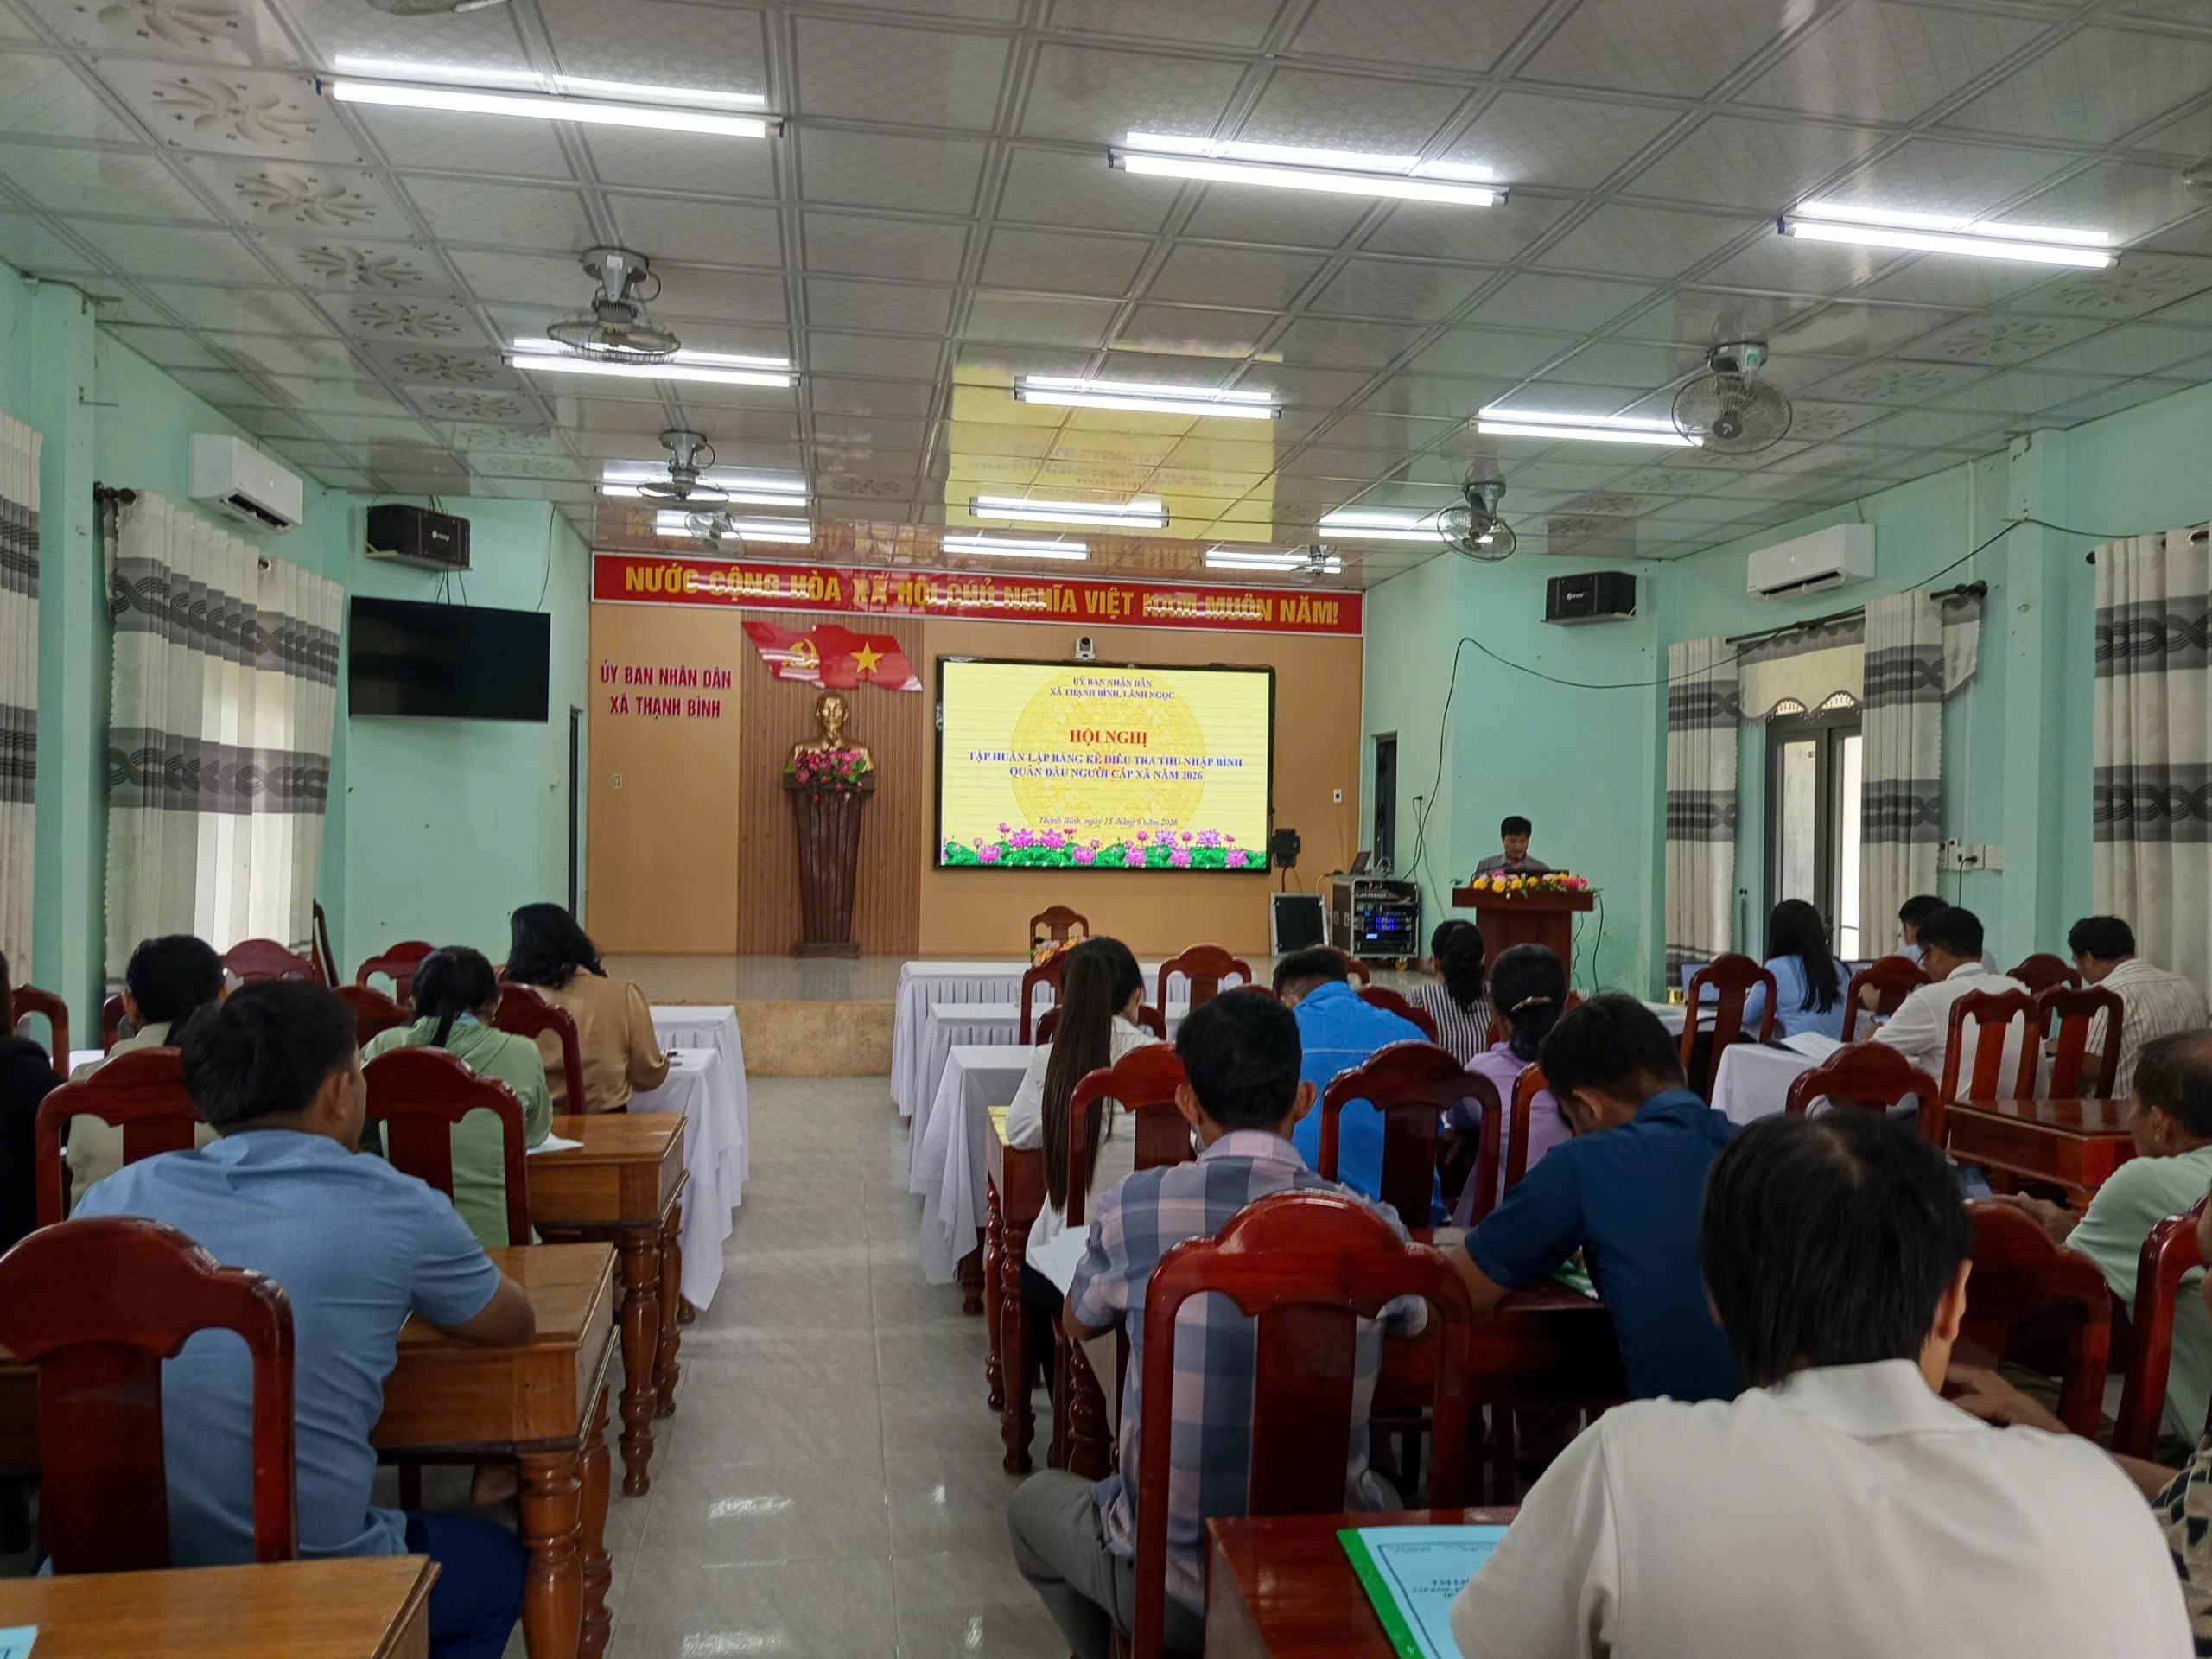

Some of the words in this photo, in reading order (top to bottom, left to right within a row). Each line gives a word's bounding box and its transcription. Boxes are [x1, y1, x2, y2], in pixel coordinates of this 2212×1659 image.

[625, 563, 699, 594] NƯỚC
[709, 566, 780, 602] CỘNG
[790, 569, 842, 602] HÒA
[852, 573, 888, 604] XÃ
[899, 575, 938, 607] HỘI
[947, 577, 995, 608] CHỦ
[1003, 584, 1076, 613] NGHĨA
[1084, 588, 1134, 620] VIỆT
[1142, 593, 1197, 619] NAM
[1205, 594, 1272, 622] MUÔN
[1280, 594, 1338, 625] NĂM!
[601, 659, 619, 684] ỦY
[625, 665, 654, 685] BAN
[659, 664, 698, 687] NHÂN
[703, 665, 732, 689] DÂN
[1088, 677, 1105, 686] BAN
[1108, 677, 1132, 688] NHÂN
[1135, 678, 1153, 688] DÂN
[1065, 689, 1095, 698] THẠNH
[1150, 690, 1174, 701] NGỌC
[610, 692, 629, 715] XÃ
[635, 696, 682, 720] THẠNH
[687, 695, 721, 719] BÌNH
[1071, 728, 1100, 746] HỘI
[1105, 730, 1147, 747] NGHỊ
[968, 750, 990, 763] TẬP
[993, 750, 1025, 762] HUẤN
[1028, 751, 1050, 765] LẬP
[1052, 752, 1083, 764] BẢNG
[1086, 752, 1102, 764] KÊ
[1134, 755, 1156, 766] TRA
[1158, 756, 1181, 766] THU
[1184, 755, 1213, 768] NHẬP
[1216, 755, 1243, 767] BÌNH
[1009, 765, 1042, 777] QUÂN
[1071, 766, 1109, 779] NGƯỜI
[1135, 768, 1150, 779] XÃ
[1154, 768, 1179, 779] NĂM
[1182, 770, 1203, 780] 2026
[1084, 817, 1103, 828] ngày
[1115, 817, 1135, 828] tháng
[1161, 818, 1179, 827] 2026
